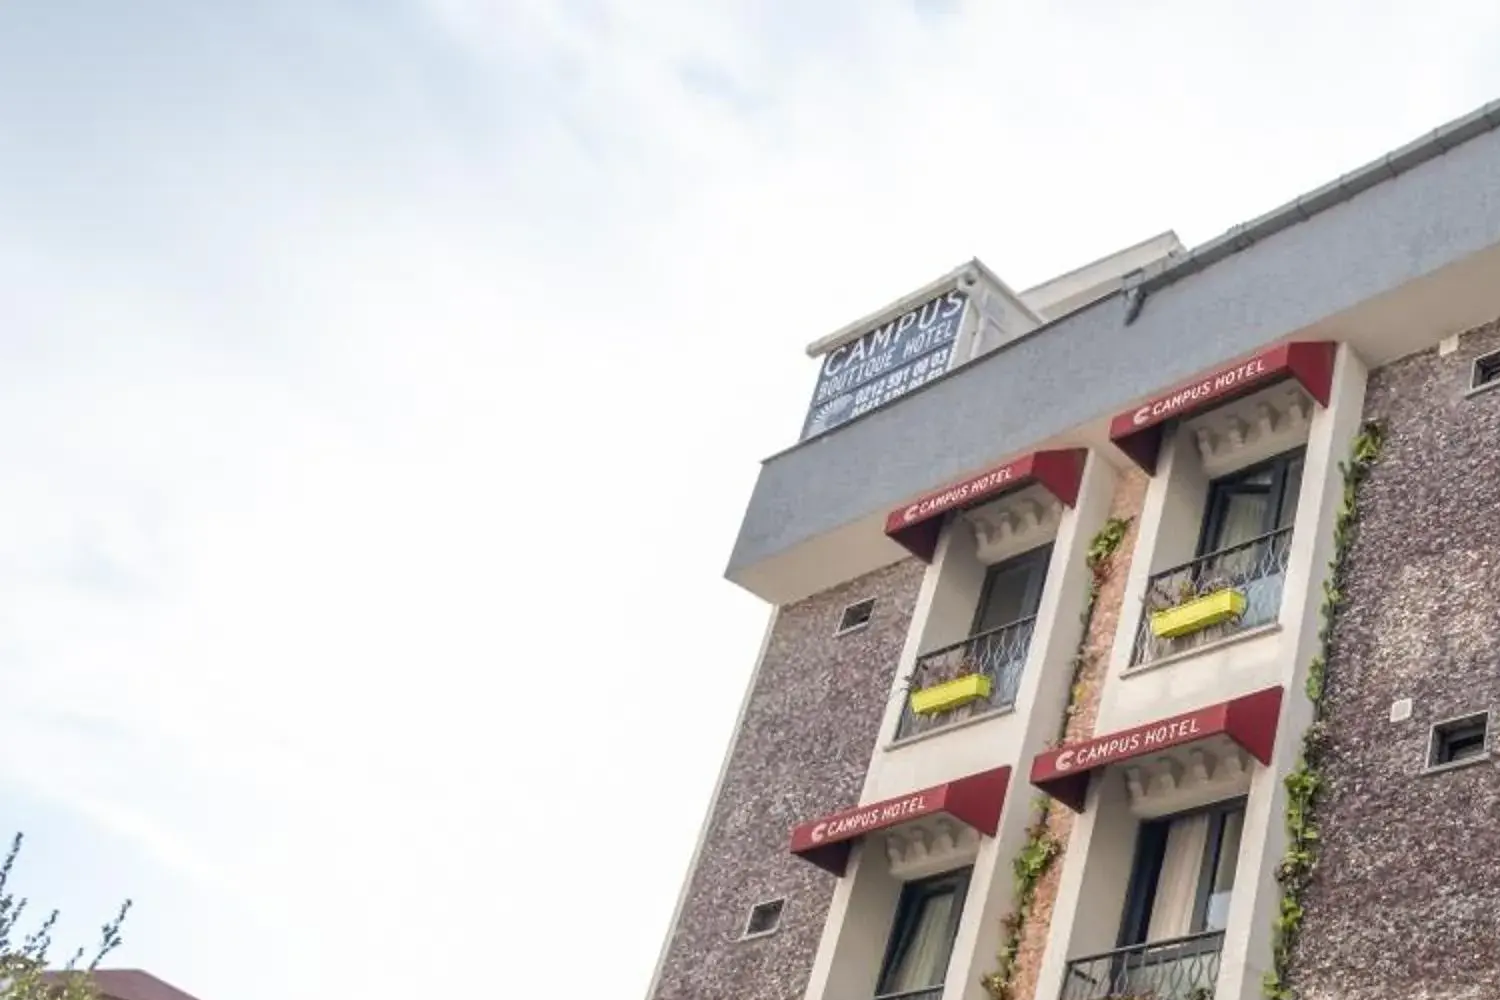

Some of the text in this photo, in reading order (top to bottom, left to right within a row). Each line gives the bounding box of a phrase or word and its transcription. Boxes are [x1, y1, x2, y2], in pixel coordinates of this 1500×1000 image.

[825, 291, 963, 376] CAMPUS
[902, 319, 952, 359] HOTEL
[1152, 381, 1212, 415] CAMPUS
[1215, 359, 1265, 389] HOTEL
[919, 484, 970, 514] CAMPUS
[971, 467, 1013, 494] HOTEL
[1076, 734, 1140, 765] CAMPUS
[1144, 718, 1201, 745] HOTEL
[827, 808, 879, 836] CAMPUS
[881, 795, 927, 819] HOTEL
